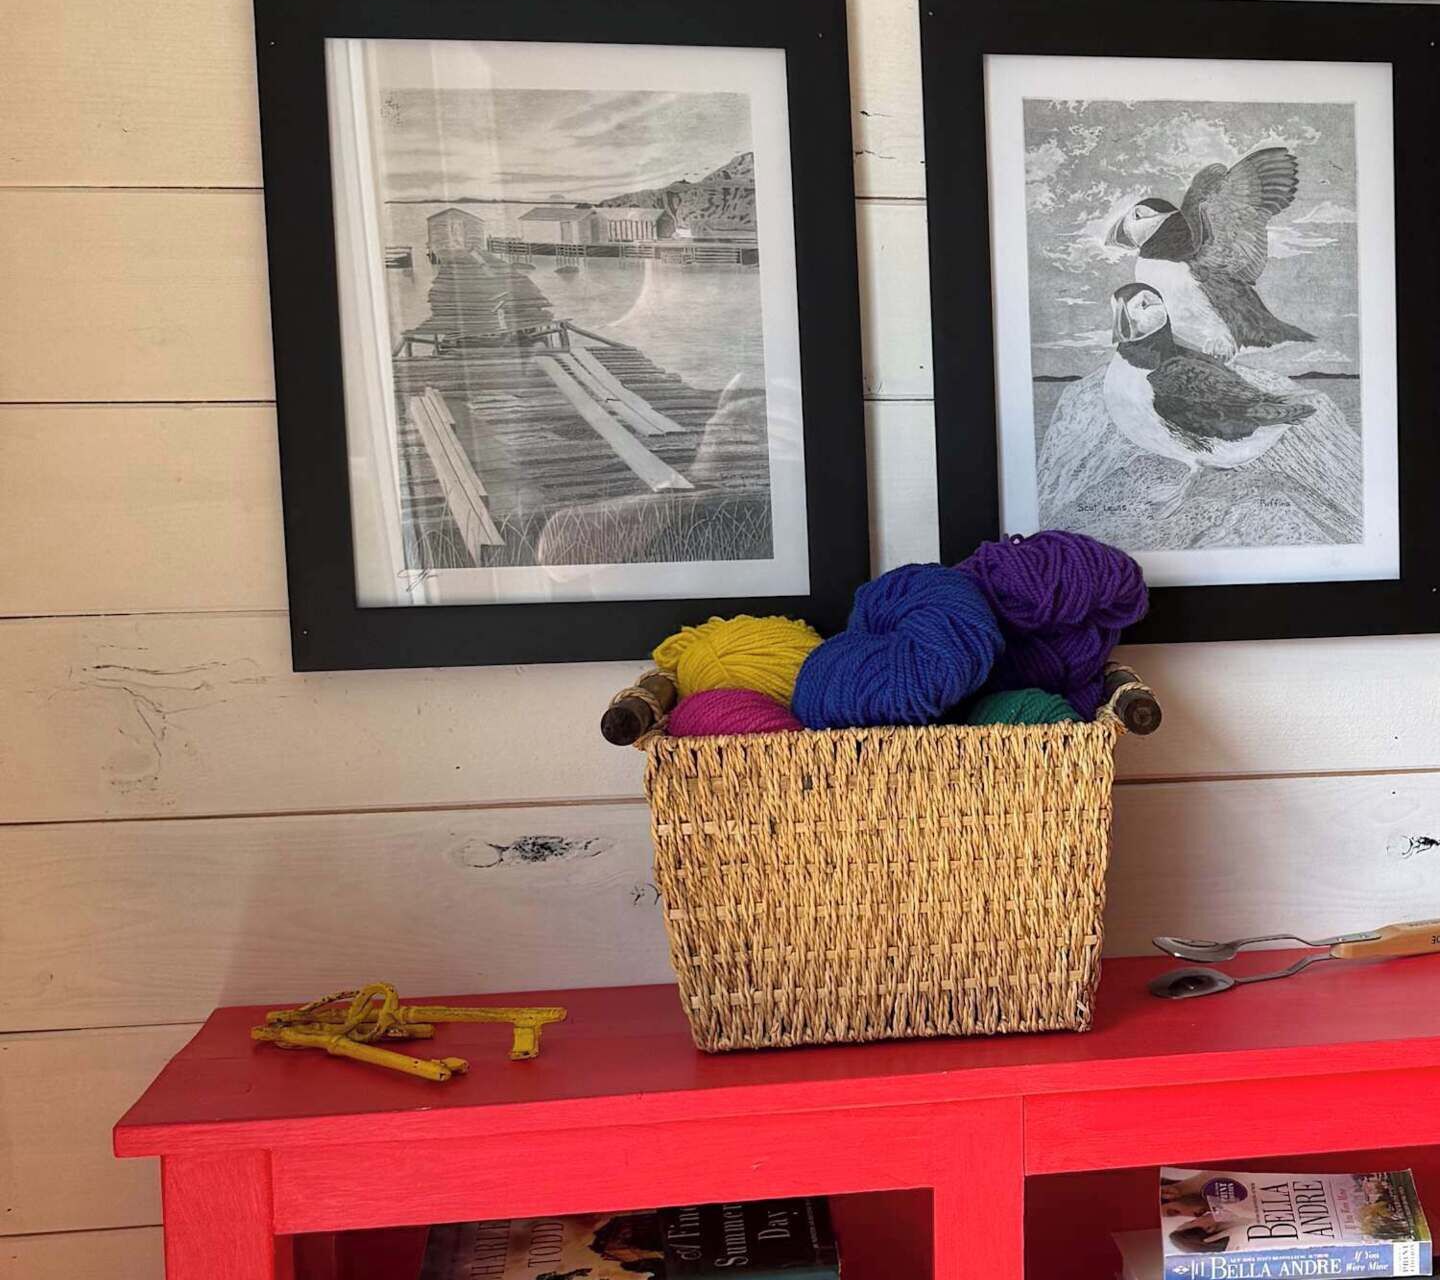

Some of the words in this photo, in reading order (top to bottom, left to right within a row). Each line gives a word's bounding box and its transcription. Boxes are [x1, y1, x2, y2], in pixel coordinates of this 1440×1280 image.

[1247, 1182, 1299, 1241] BELLA
[1293, 1180, 1335, 1239] ANDRE
[1209, 1256, 1271, 1280] BELLA
[1275, 1258, 1342, 1276] ANDRE
